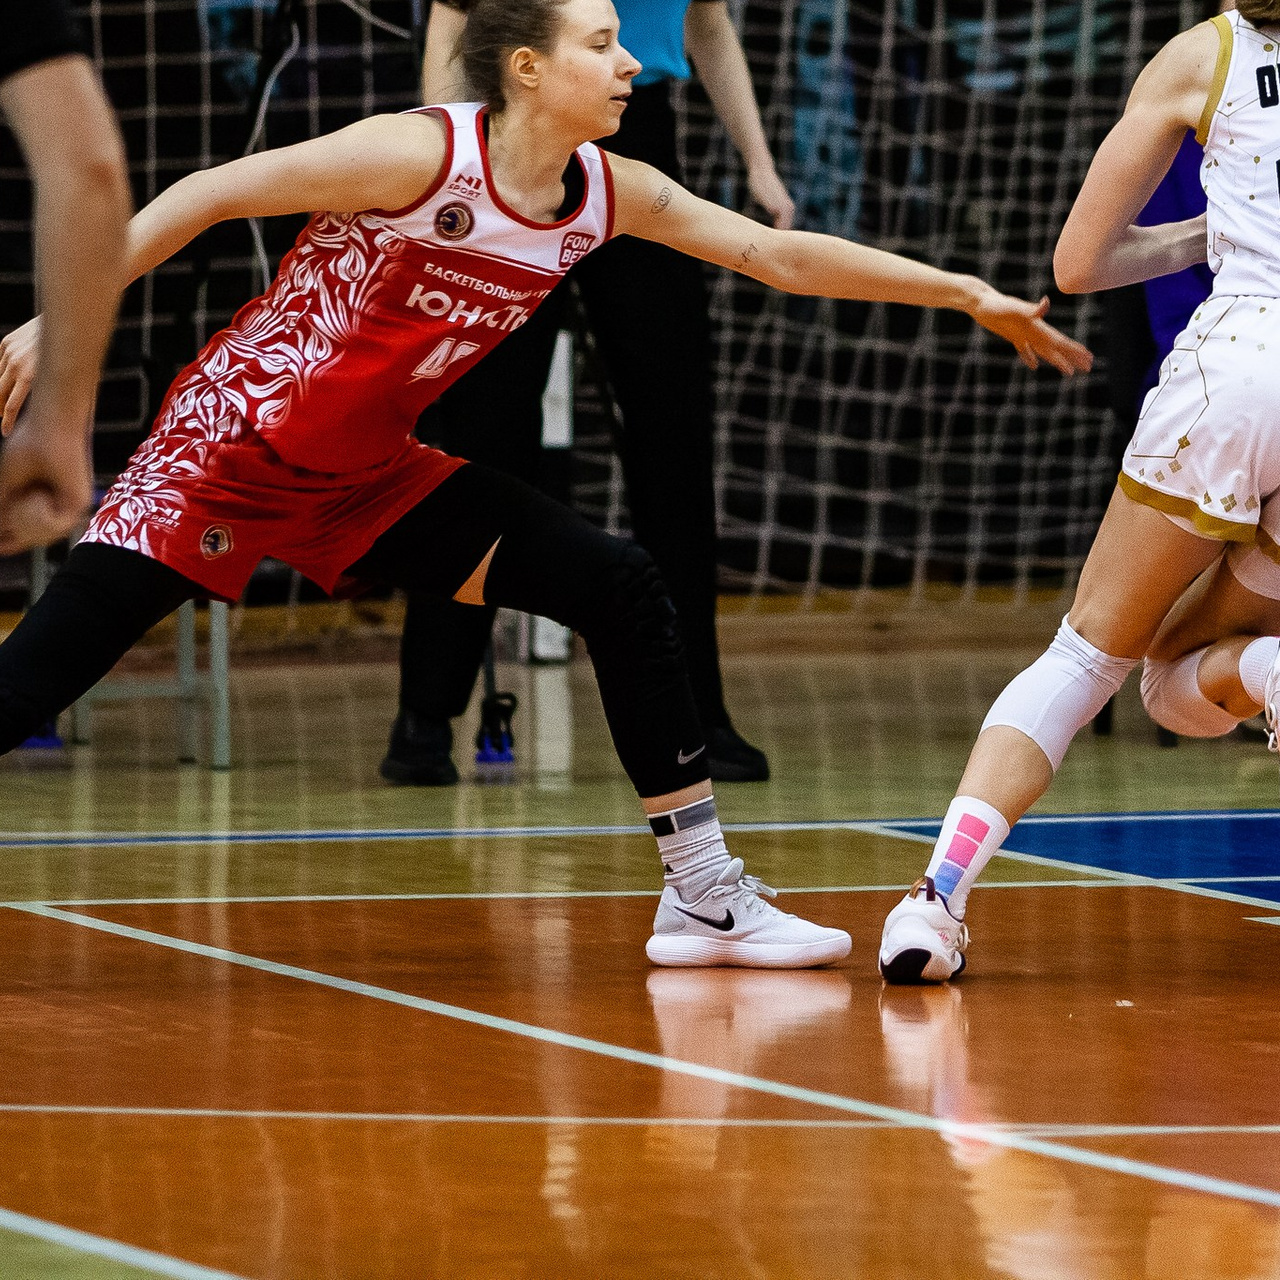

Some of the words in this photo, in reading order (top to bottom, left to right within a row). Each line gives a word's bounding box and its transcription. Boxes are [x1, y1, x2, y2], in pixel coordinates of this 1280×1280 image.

[447, 183, 482, 199] SPORT
[563, 234, 593, 250] FON
[405, 284, 529, 332] ЮНСТЬ
[144, 513, 181, 528] SPORT
